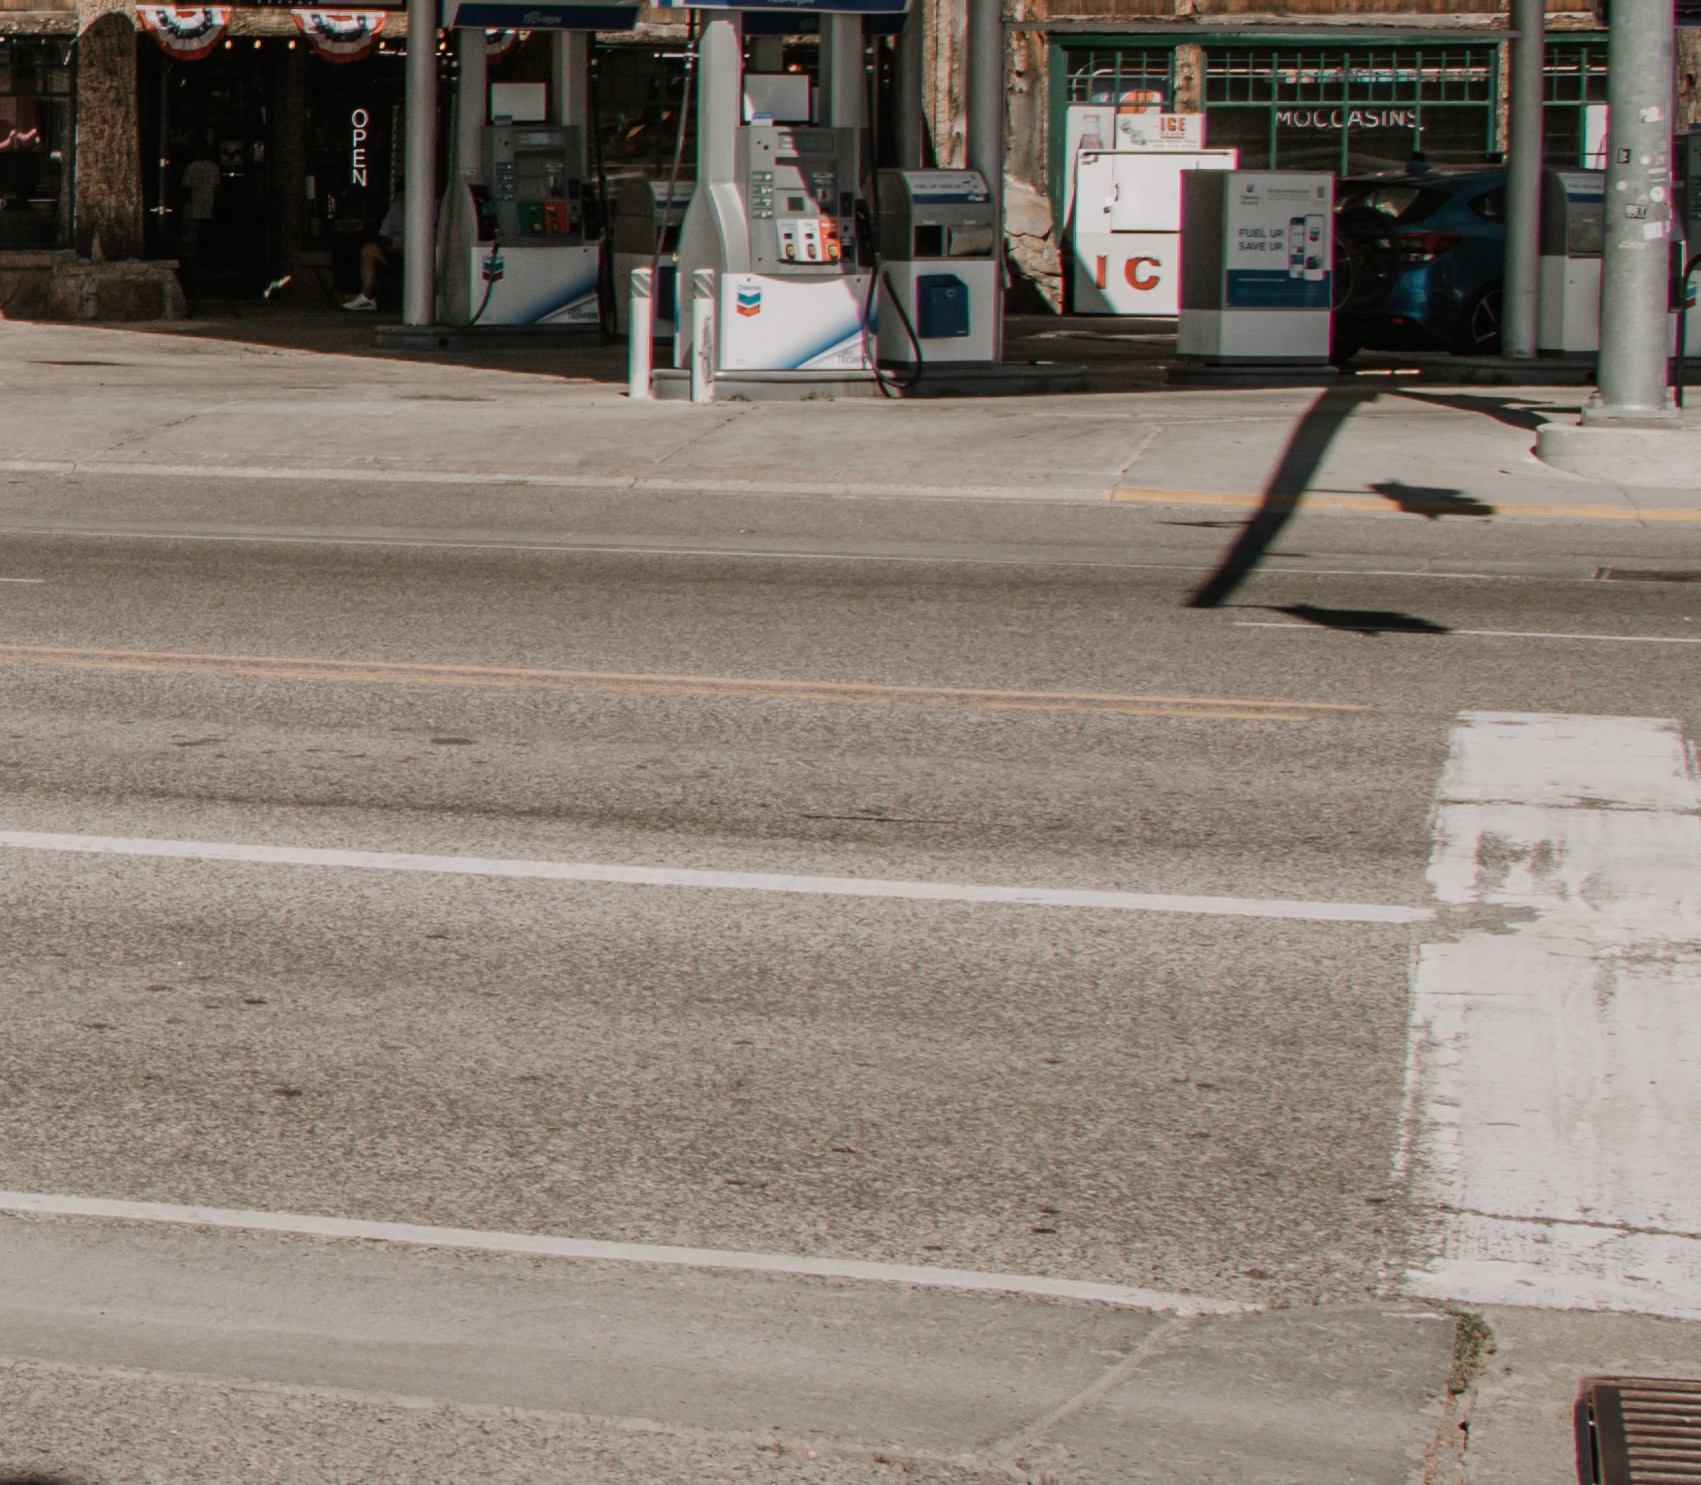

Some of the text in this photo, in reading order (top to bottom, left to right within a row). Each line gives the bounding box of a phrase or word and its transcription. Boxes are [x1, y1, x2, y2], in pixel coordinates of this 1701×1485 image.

[1159, 116, 1186, 132] ICE
[1275, 108, 1418, 129] MOCCASINS
[351, 108, 368, 187] OPEN
[1238, 228, 1266, 239] FUEL
[1238, 241, 1266, 252] SAVE
